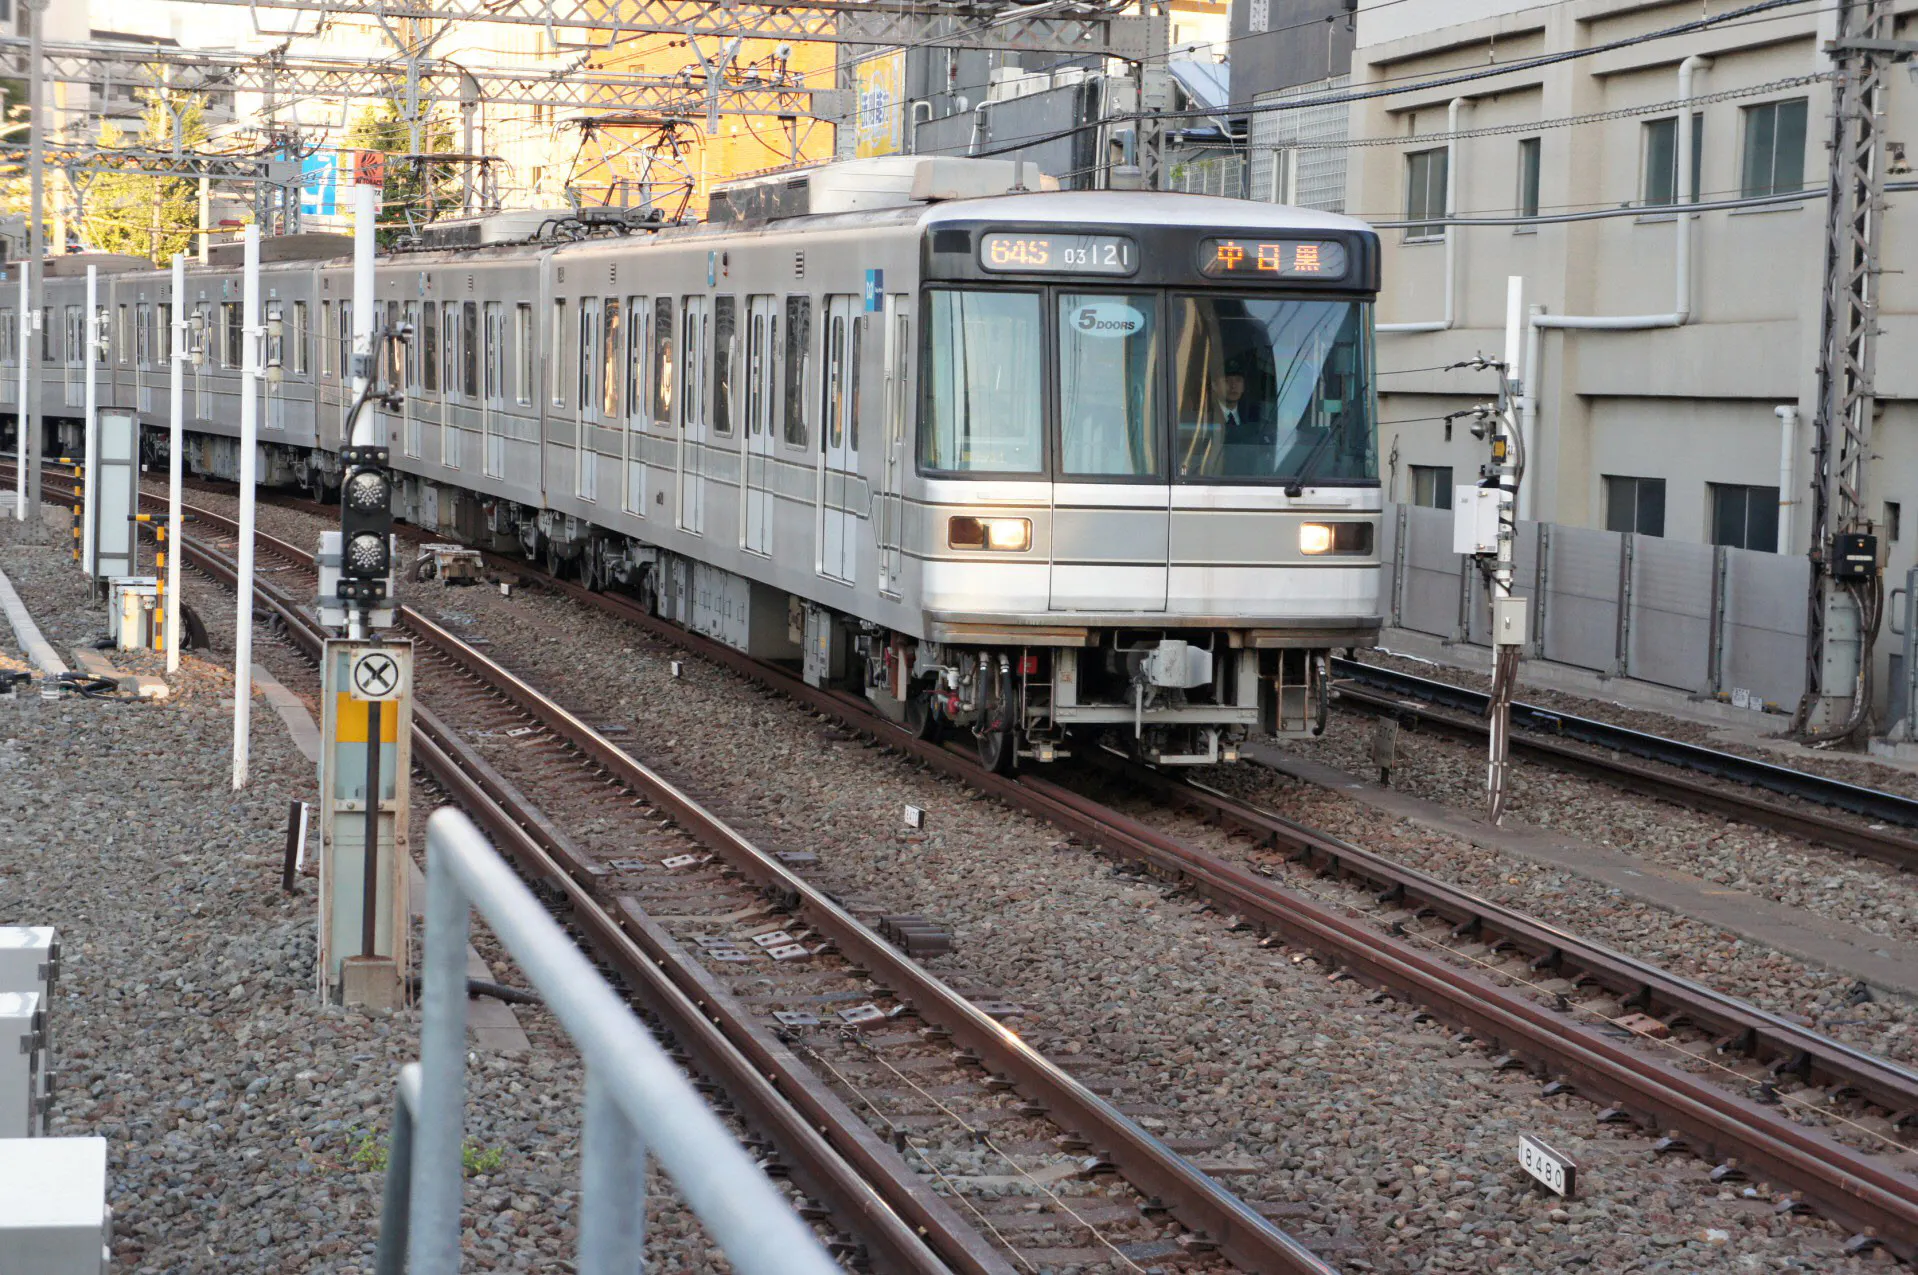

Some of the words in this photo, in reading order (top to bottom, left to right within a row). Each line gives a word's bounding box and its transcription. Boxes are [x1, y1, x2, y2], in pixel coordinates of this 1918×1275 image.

[991, 239, 1049, 265] 64S
[1078, 309, 1097, 330] 5
[1096, 320, 1136, 330] DOORS
